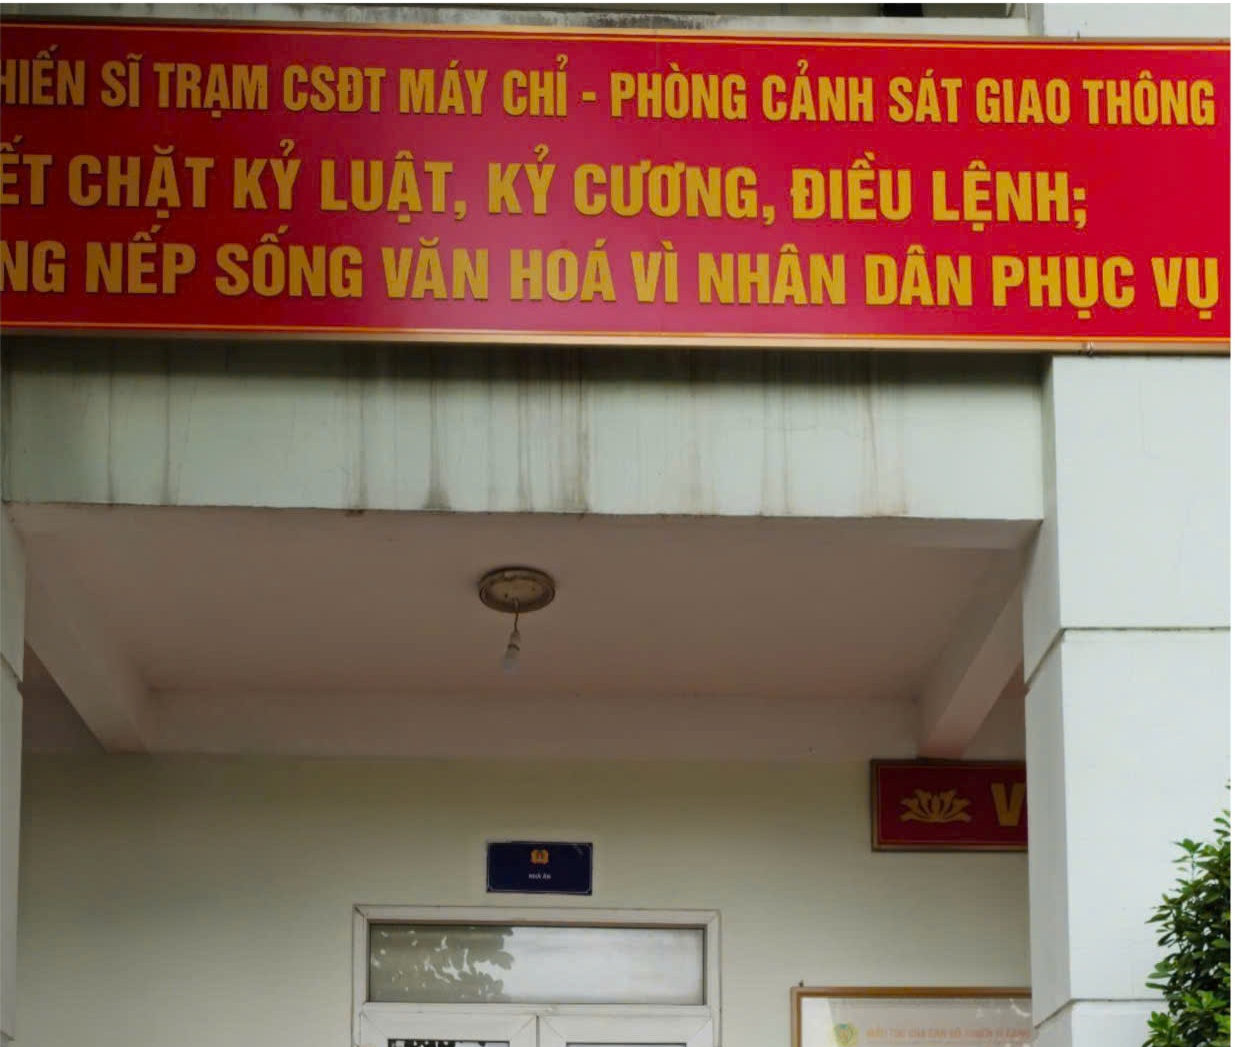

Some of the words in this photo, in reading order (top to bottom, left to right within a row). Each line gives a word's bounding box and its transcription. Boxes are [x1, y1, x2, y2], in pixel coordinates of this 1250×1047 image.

[101, 53, 140, 107] SĨ
[154, 63, 268, 119] TRẠM
[283, 65, 387, 113] CSĐT
[399, 60, 488, 116] MÁY
[502, 54, 568, 117] CHỈ
[581, 91, 597, 102] -
[610, 62, 747, 122] PHÒNG
[762, 59, 874, 123] CẢNH
[888, 69, 963, 124] SÁT
[975, 78, 1071, 125] GIAO
[1083, 70, 1215, 126] THÔNG
[68, 144, 214, 219] CHẶT
[233, 138, 302, 210] KỶ
[320, 150, 468, 224] LUẬT,
[487, 144, 553, 216] KỶ
[573, 160, 776, 226] CƯƠNG,
[789, 152, 912, 221] ĐIỀU
[932, 160, 1087, 231] LỆNH;
[85, 225, 197, 296] NẾP
[215, 225, 363, 300] SỐNG
[381, 236, 489, 301] VĂN
[509, 238, 616, 303] HOÁ
[630, 240, 679, 304] VÌ
[697, 243, 847, 306] NHÂN
[864, 245, 973, 307] DÂN
[991, 255, 1135, 320] PHỤC
[1151, 257, 1219, 320] VỤ
